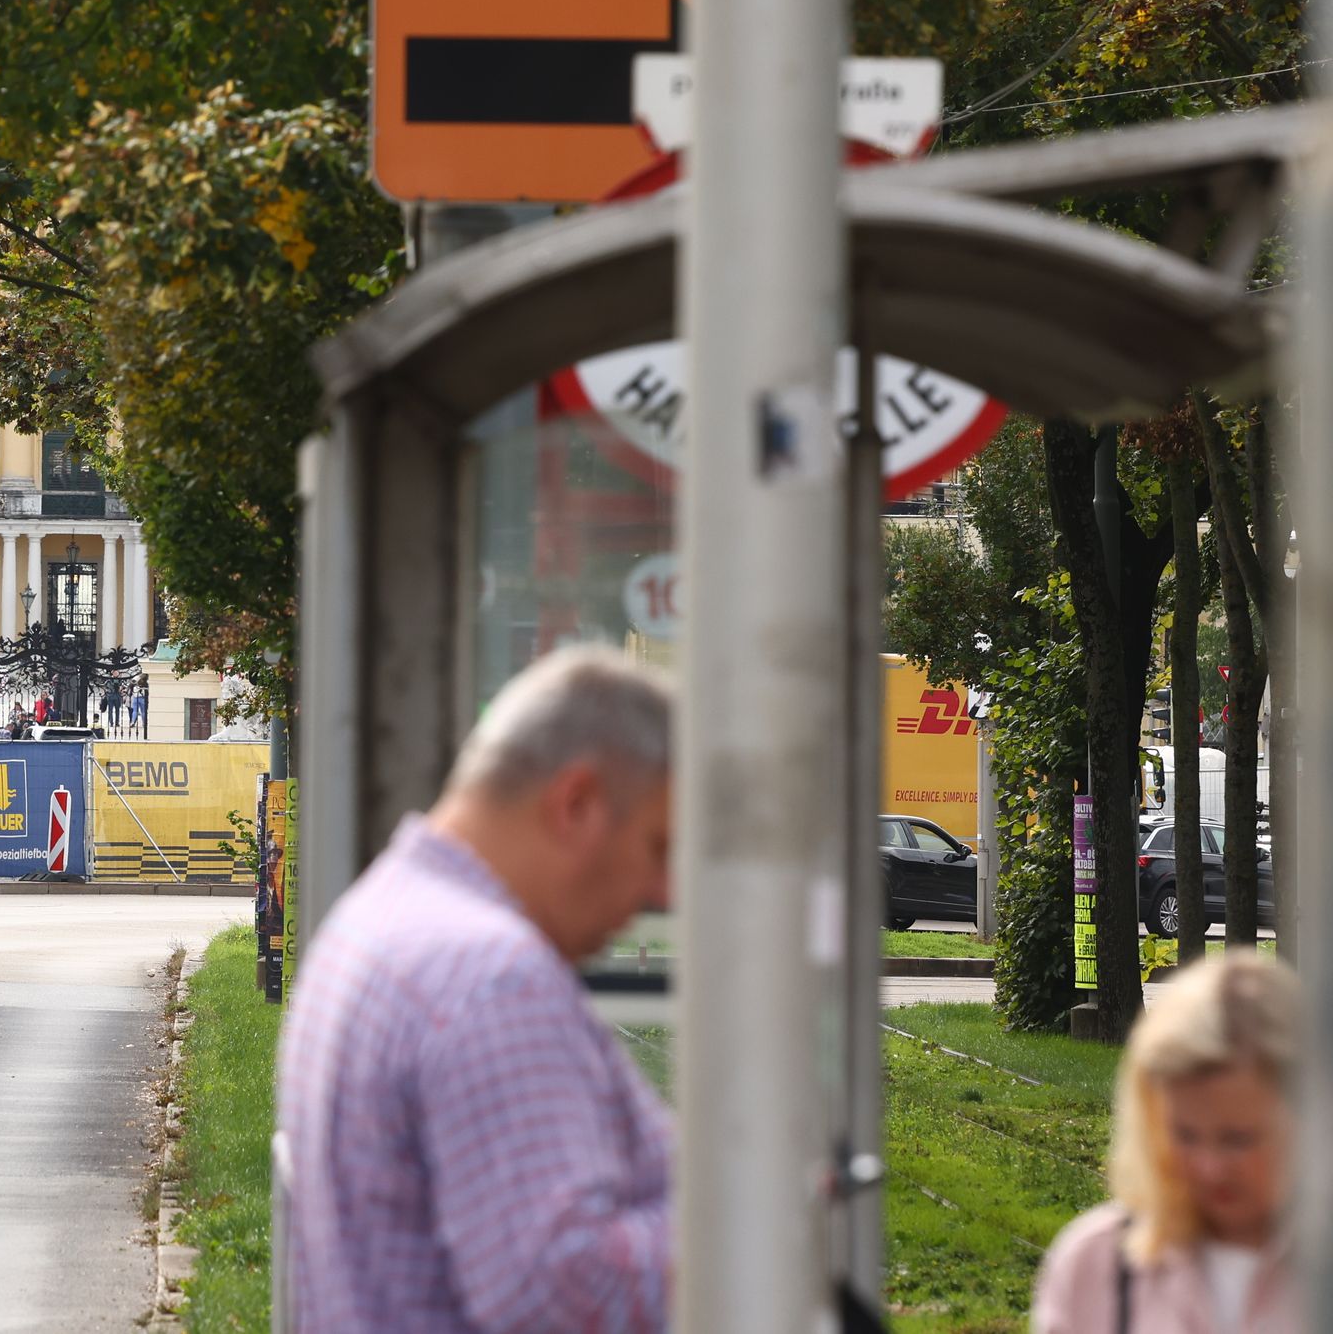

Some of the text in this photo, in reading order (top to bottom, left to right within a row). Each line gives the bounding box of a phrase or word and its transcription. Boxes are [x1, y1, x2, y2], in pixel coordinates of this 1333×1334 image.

[106, 761, 189, 788] BEMO
[895, 790, 941, 802] EXCELLENCE.
[943, 792, 967, 803] SIMPLY
[1075, 804, 1093, 813] CULTIV
